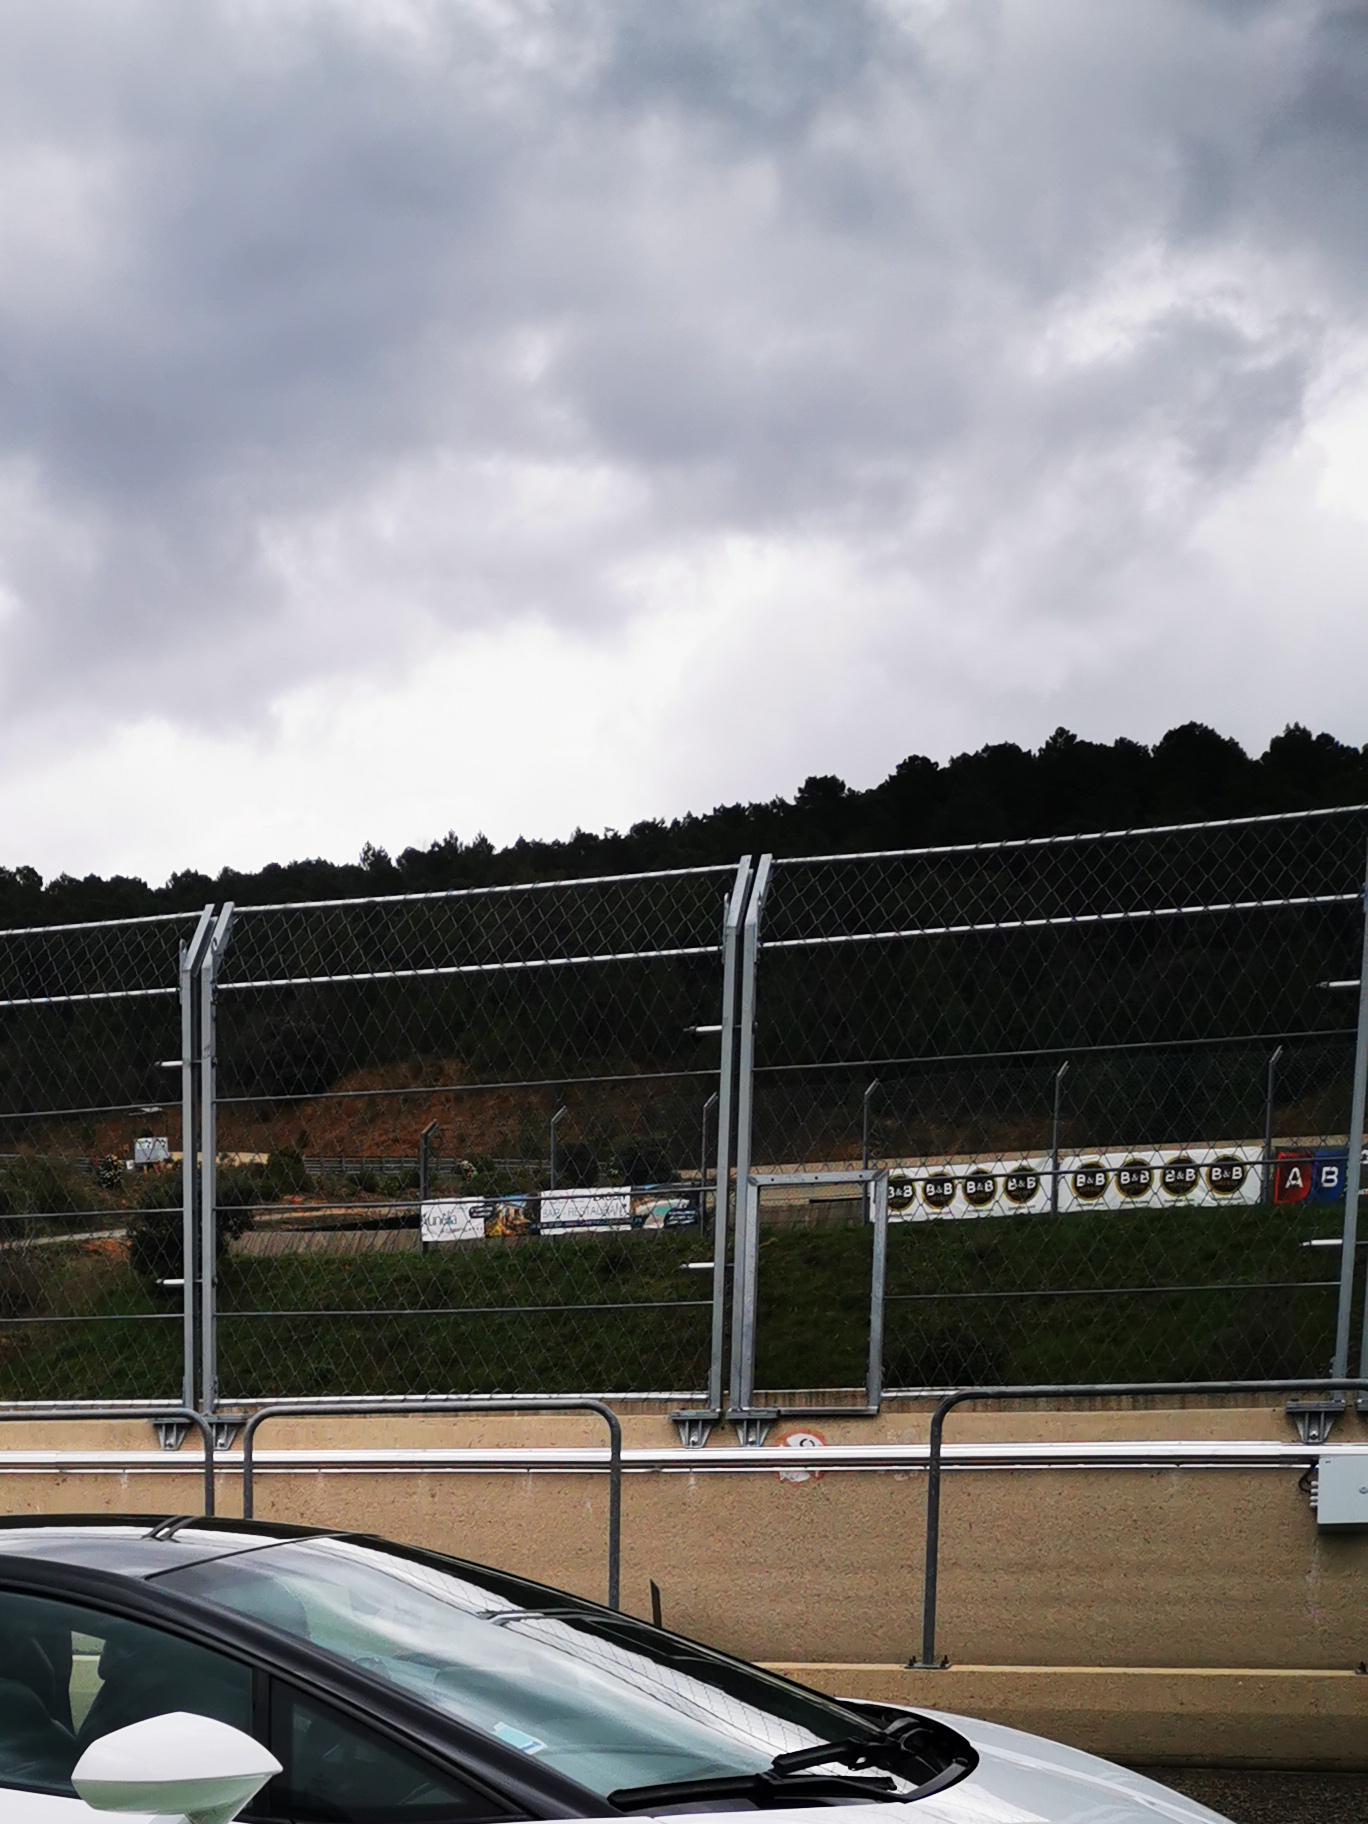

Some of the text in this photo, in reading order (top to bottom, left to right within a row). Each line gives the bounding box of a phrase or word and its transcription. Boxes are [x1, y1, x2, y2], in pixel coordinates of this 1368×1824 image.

[1076, 1173, 1105, 1187] B&B
[1120, 1170, 1150, 1185] B&B
[1211, 1166, 1243, 1180] B&B
[1285, 1166, 1304, 1188] A
[1321, 1166, 1339, 1188] B
[925, 1182, 953, 1196] B&B
[966, 1179, 994, 1194] B&B
